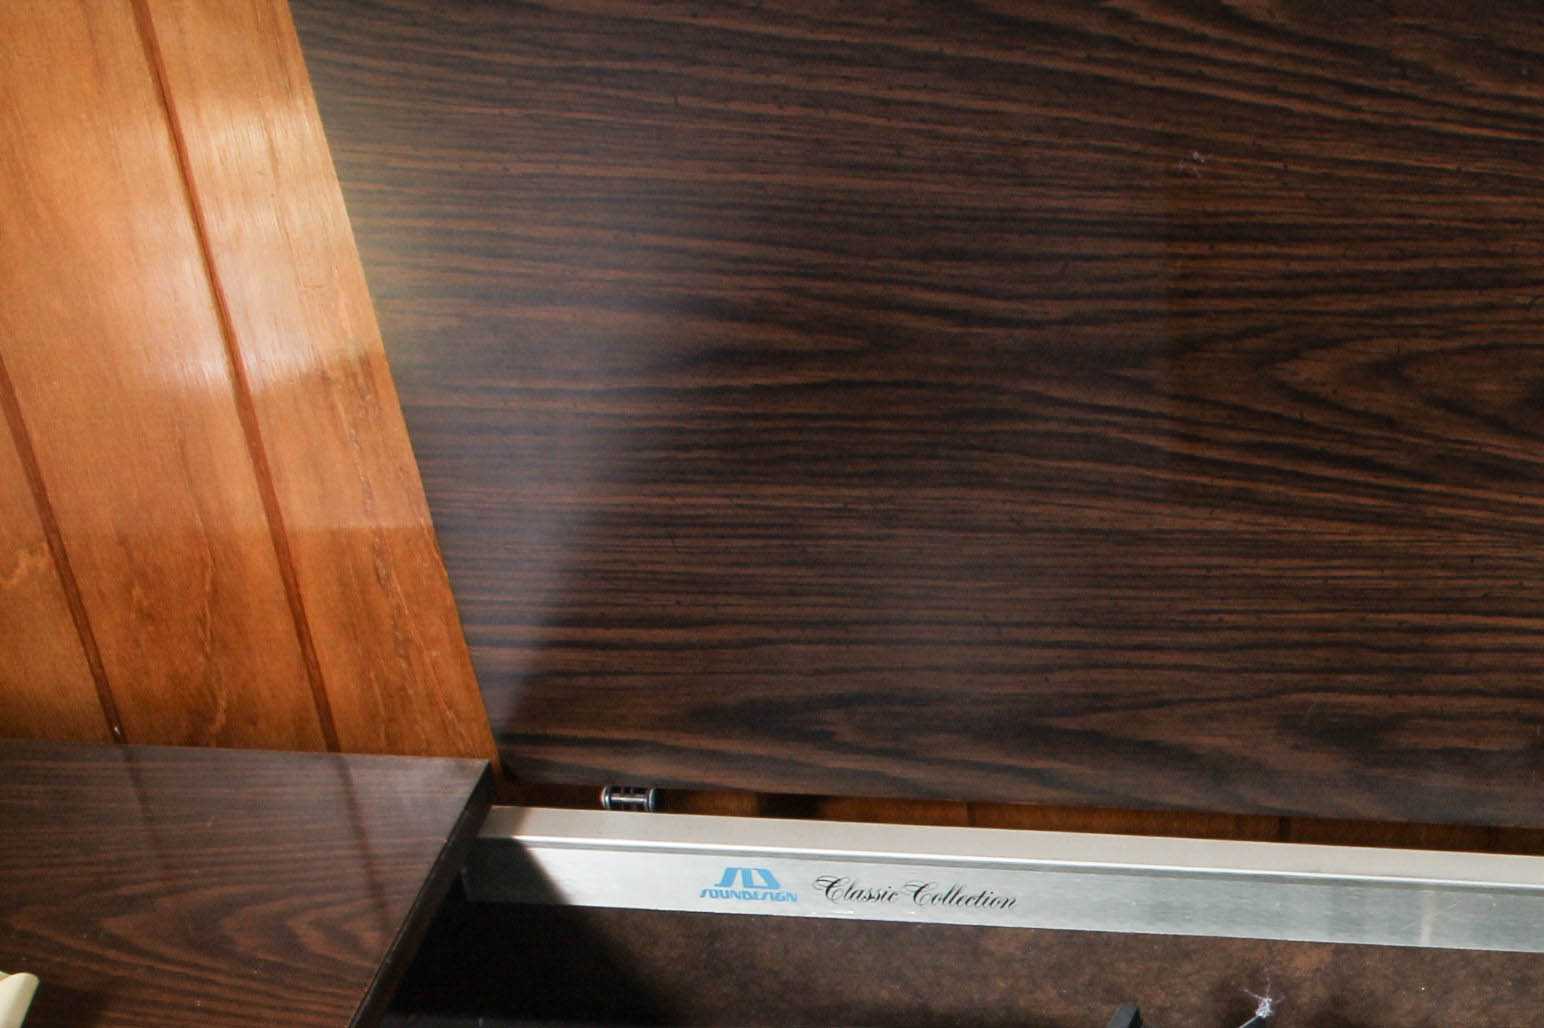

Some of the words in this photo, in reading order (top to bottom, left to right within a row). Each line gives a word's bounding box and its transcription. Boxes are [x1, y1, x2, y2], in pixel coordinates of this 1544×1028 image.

[699, 888, 798, 903] SOUNDESIGN
[813, 875, 899, 904] Classic
[904, 880, 1018, 911] Collection
